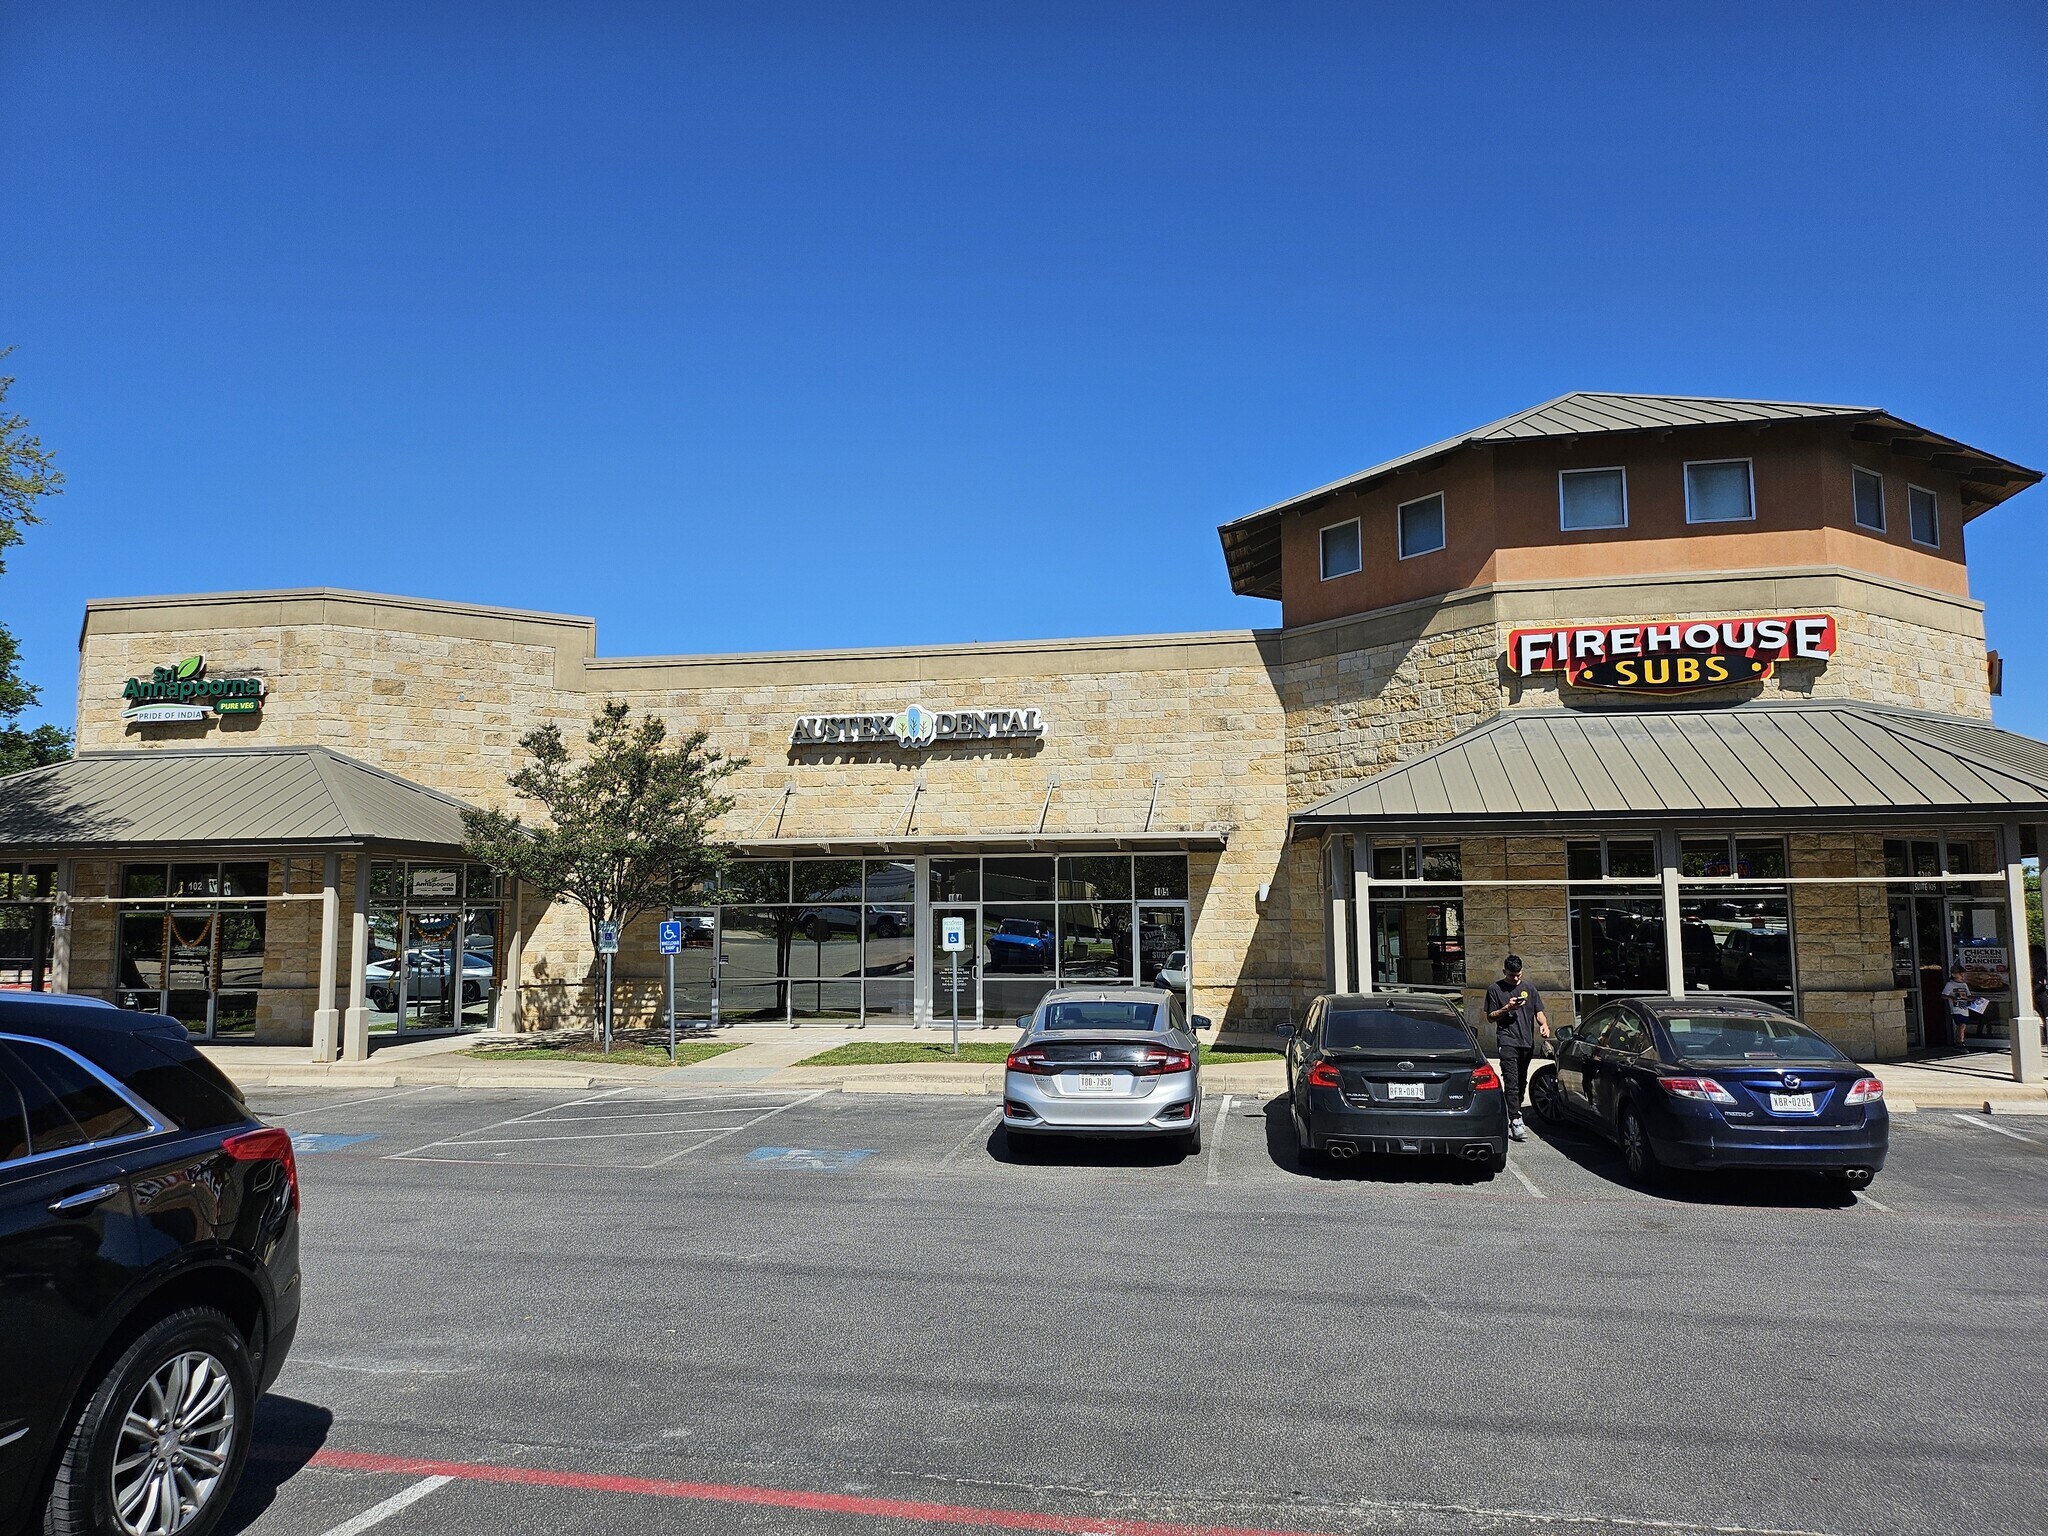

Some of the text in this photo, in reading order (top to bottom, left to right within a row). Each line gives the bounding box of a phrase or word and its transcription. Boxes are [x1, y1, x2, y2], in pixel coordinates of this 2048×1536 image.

[1520, 617, 1829, 677] FIREHOUSE
[153, 665, 175, 682] Sri
[1615, 656, 1729, 685] SUBS
[122, 678, 260, 700] Annapoorna
[138, 711, 202, 720] PRIDE OF INDIA
[792, 711, 1043, 741] AUSTEX DENTAL
[1708, 865, 1748, 877] OPN
[188, 881, 203, 891] 102
[1964, 949, 2002, 957] CHICKEN
[1965, 956, 2003, 964] RANCHER
